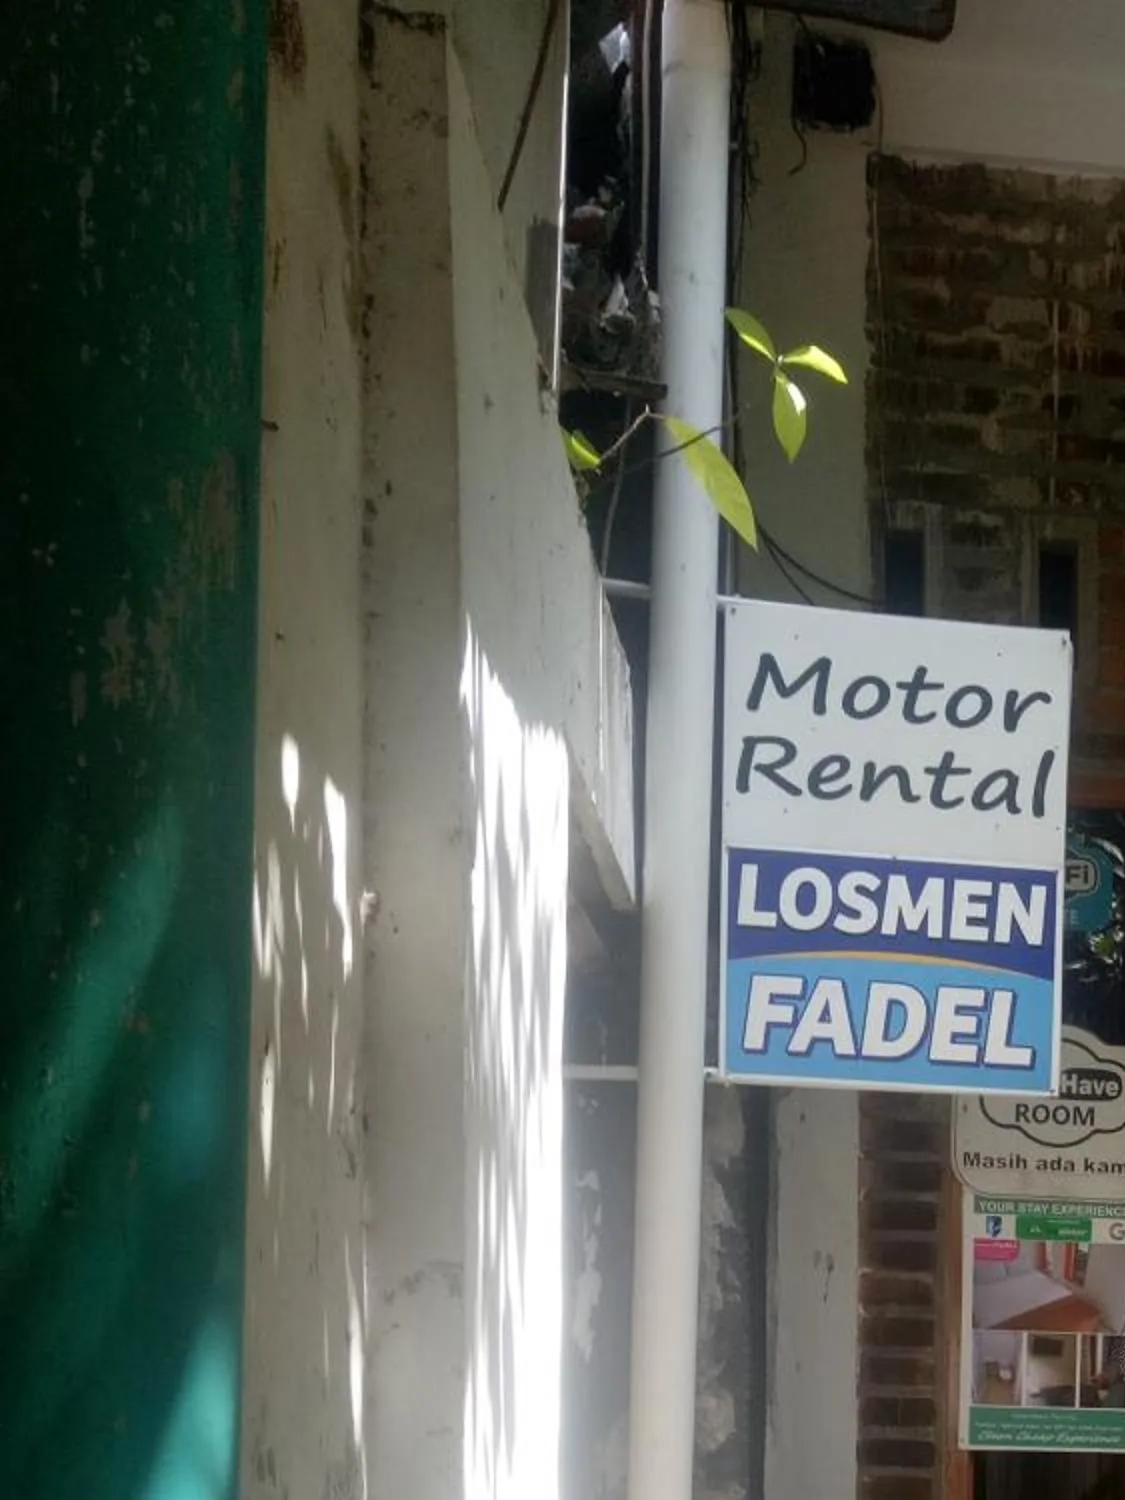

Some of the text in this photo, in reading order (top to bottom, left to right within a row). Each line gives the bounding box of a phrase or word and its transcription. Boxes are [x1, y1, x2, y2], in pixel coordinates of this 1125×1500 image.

[746, 652, 1052, 733] Motor
[735, 735, 1056, 818] Rental
[737, 862, 1047, 946] LOSMEN
[742, 972, 1036, 1070] FADEL
[1015, 1103, 1096, 1127] ROOM
[1061, 1073, 1120, 1096] Have
[963, 1151, 1028, 1171] Masih
[1035, 1156, 1075, 1172] ada
